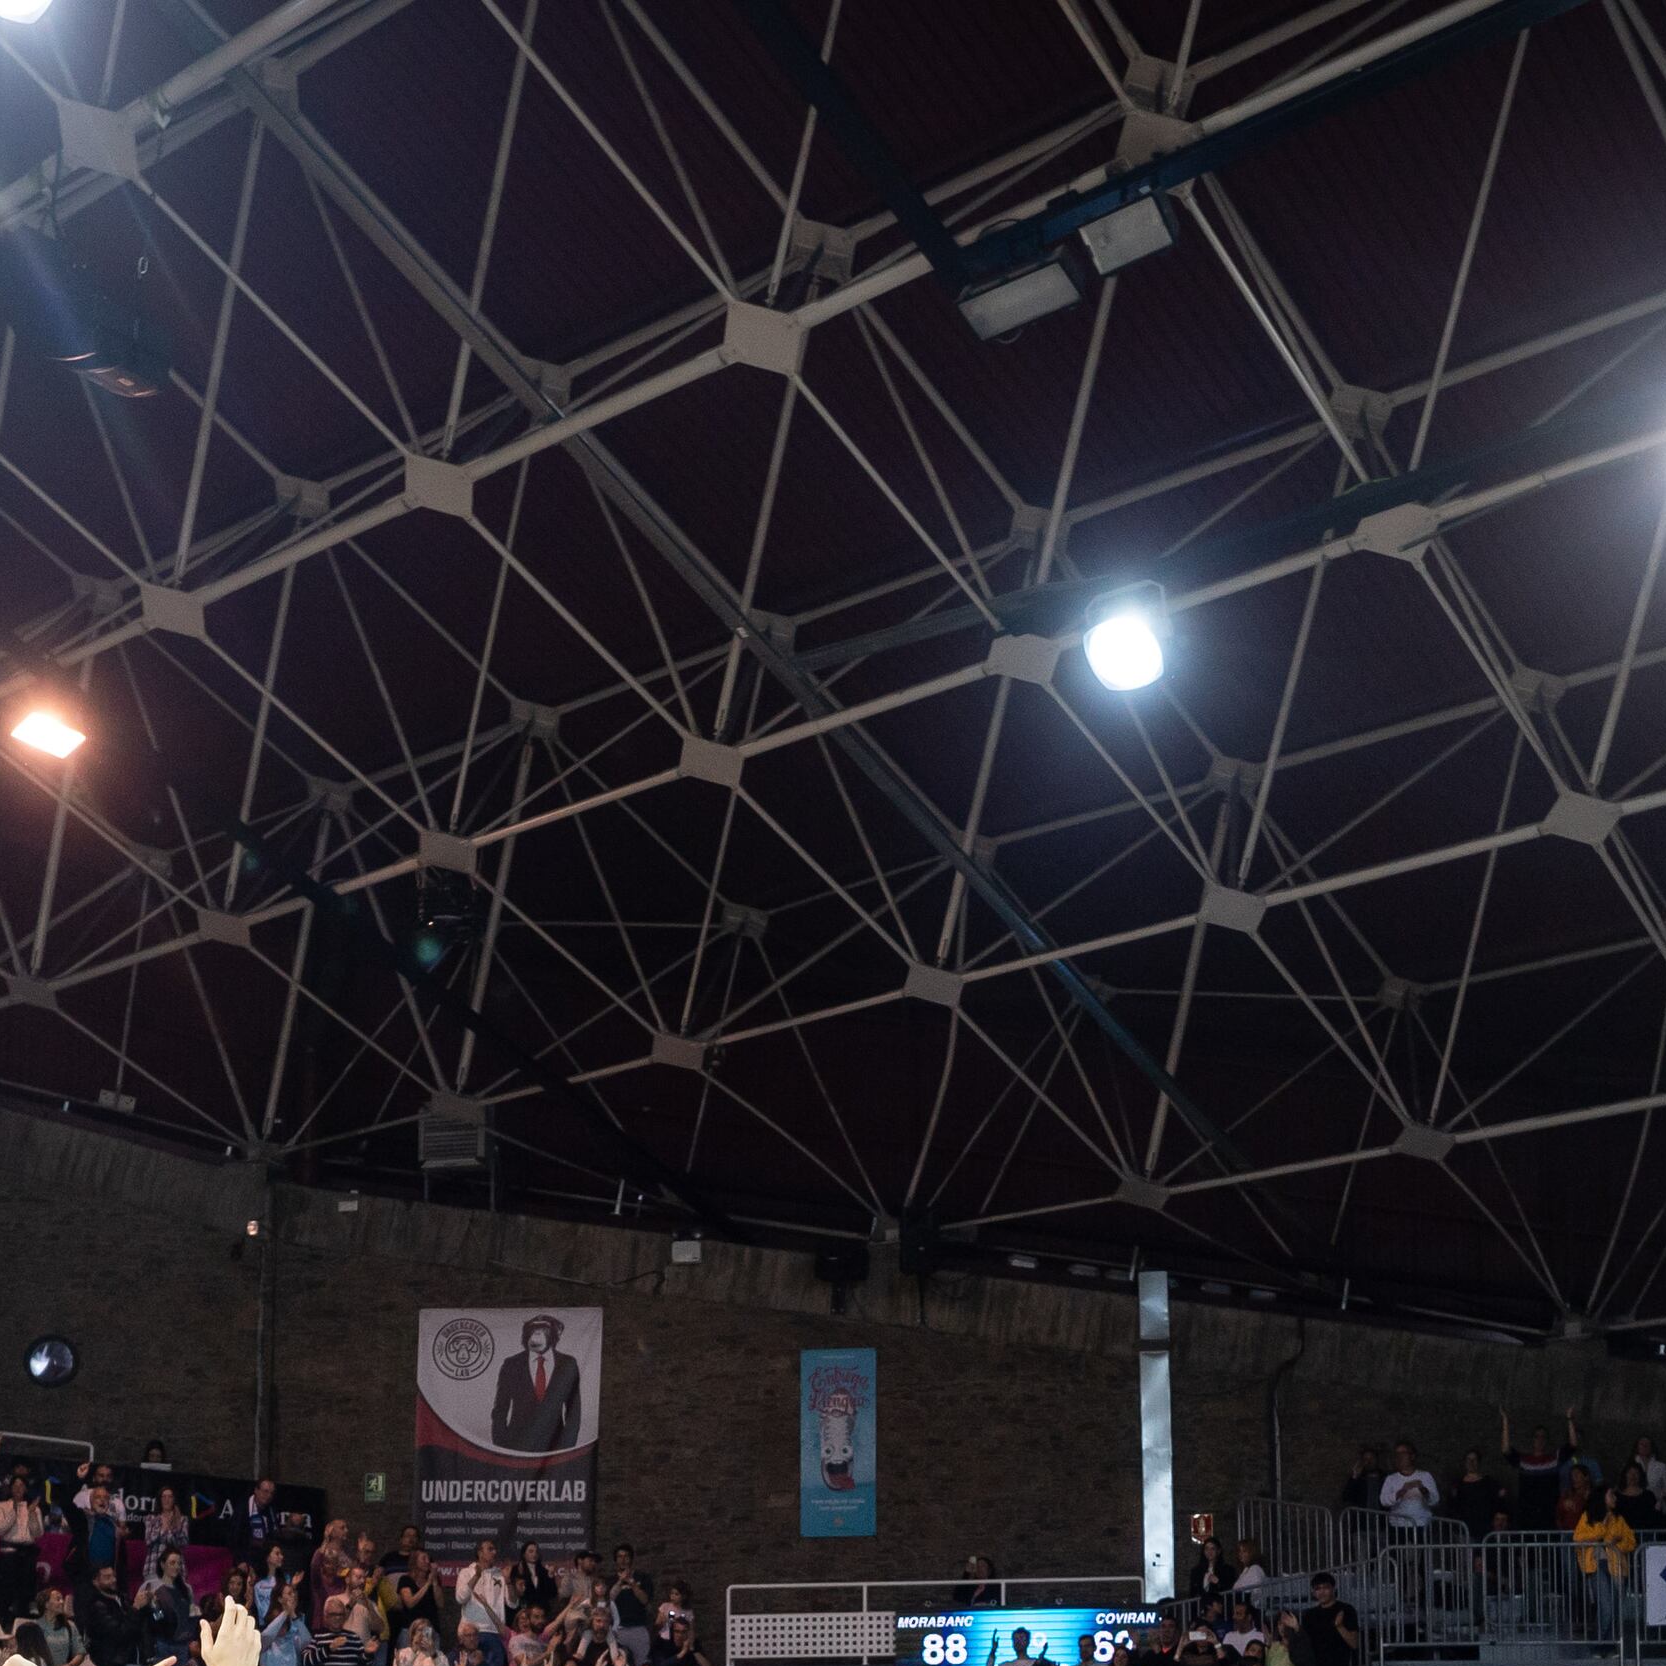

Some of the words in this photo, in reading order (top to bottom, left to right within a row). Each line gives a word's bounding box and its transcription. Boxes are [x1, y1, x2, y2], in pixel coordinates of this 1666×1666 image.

[421, 1480, 587, 1503] UNDERCOVERLAB
[897, 1614, 975, 1630] MORABANC
[1094, 1612, 1156, 1626] COVIRAN
[921, 1633, 968, 1666] 88
